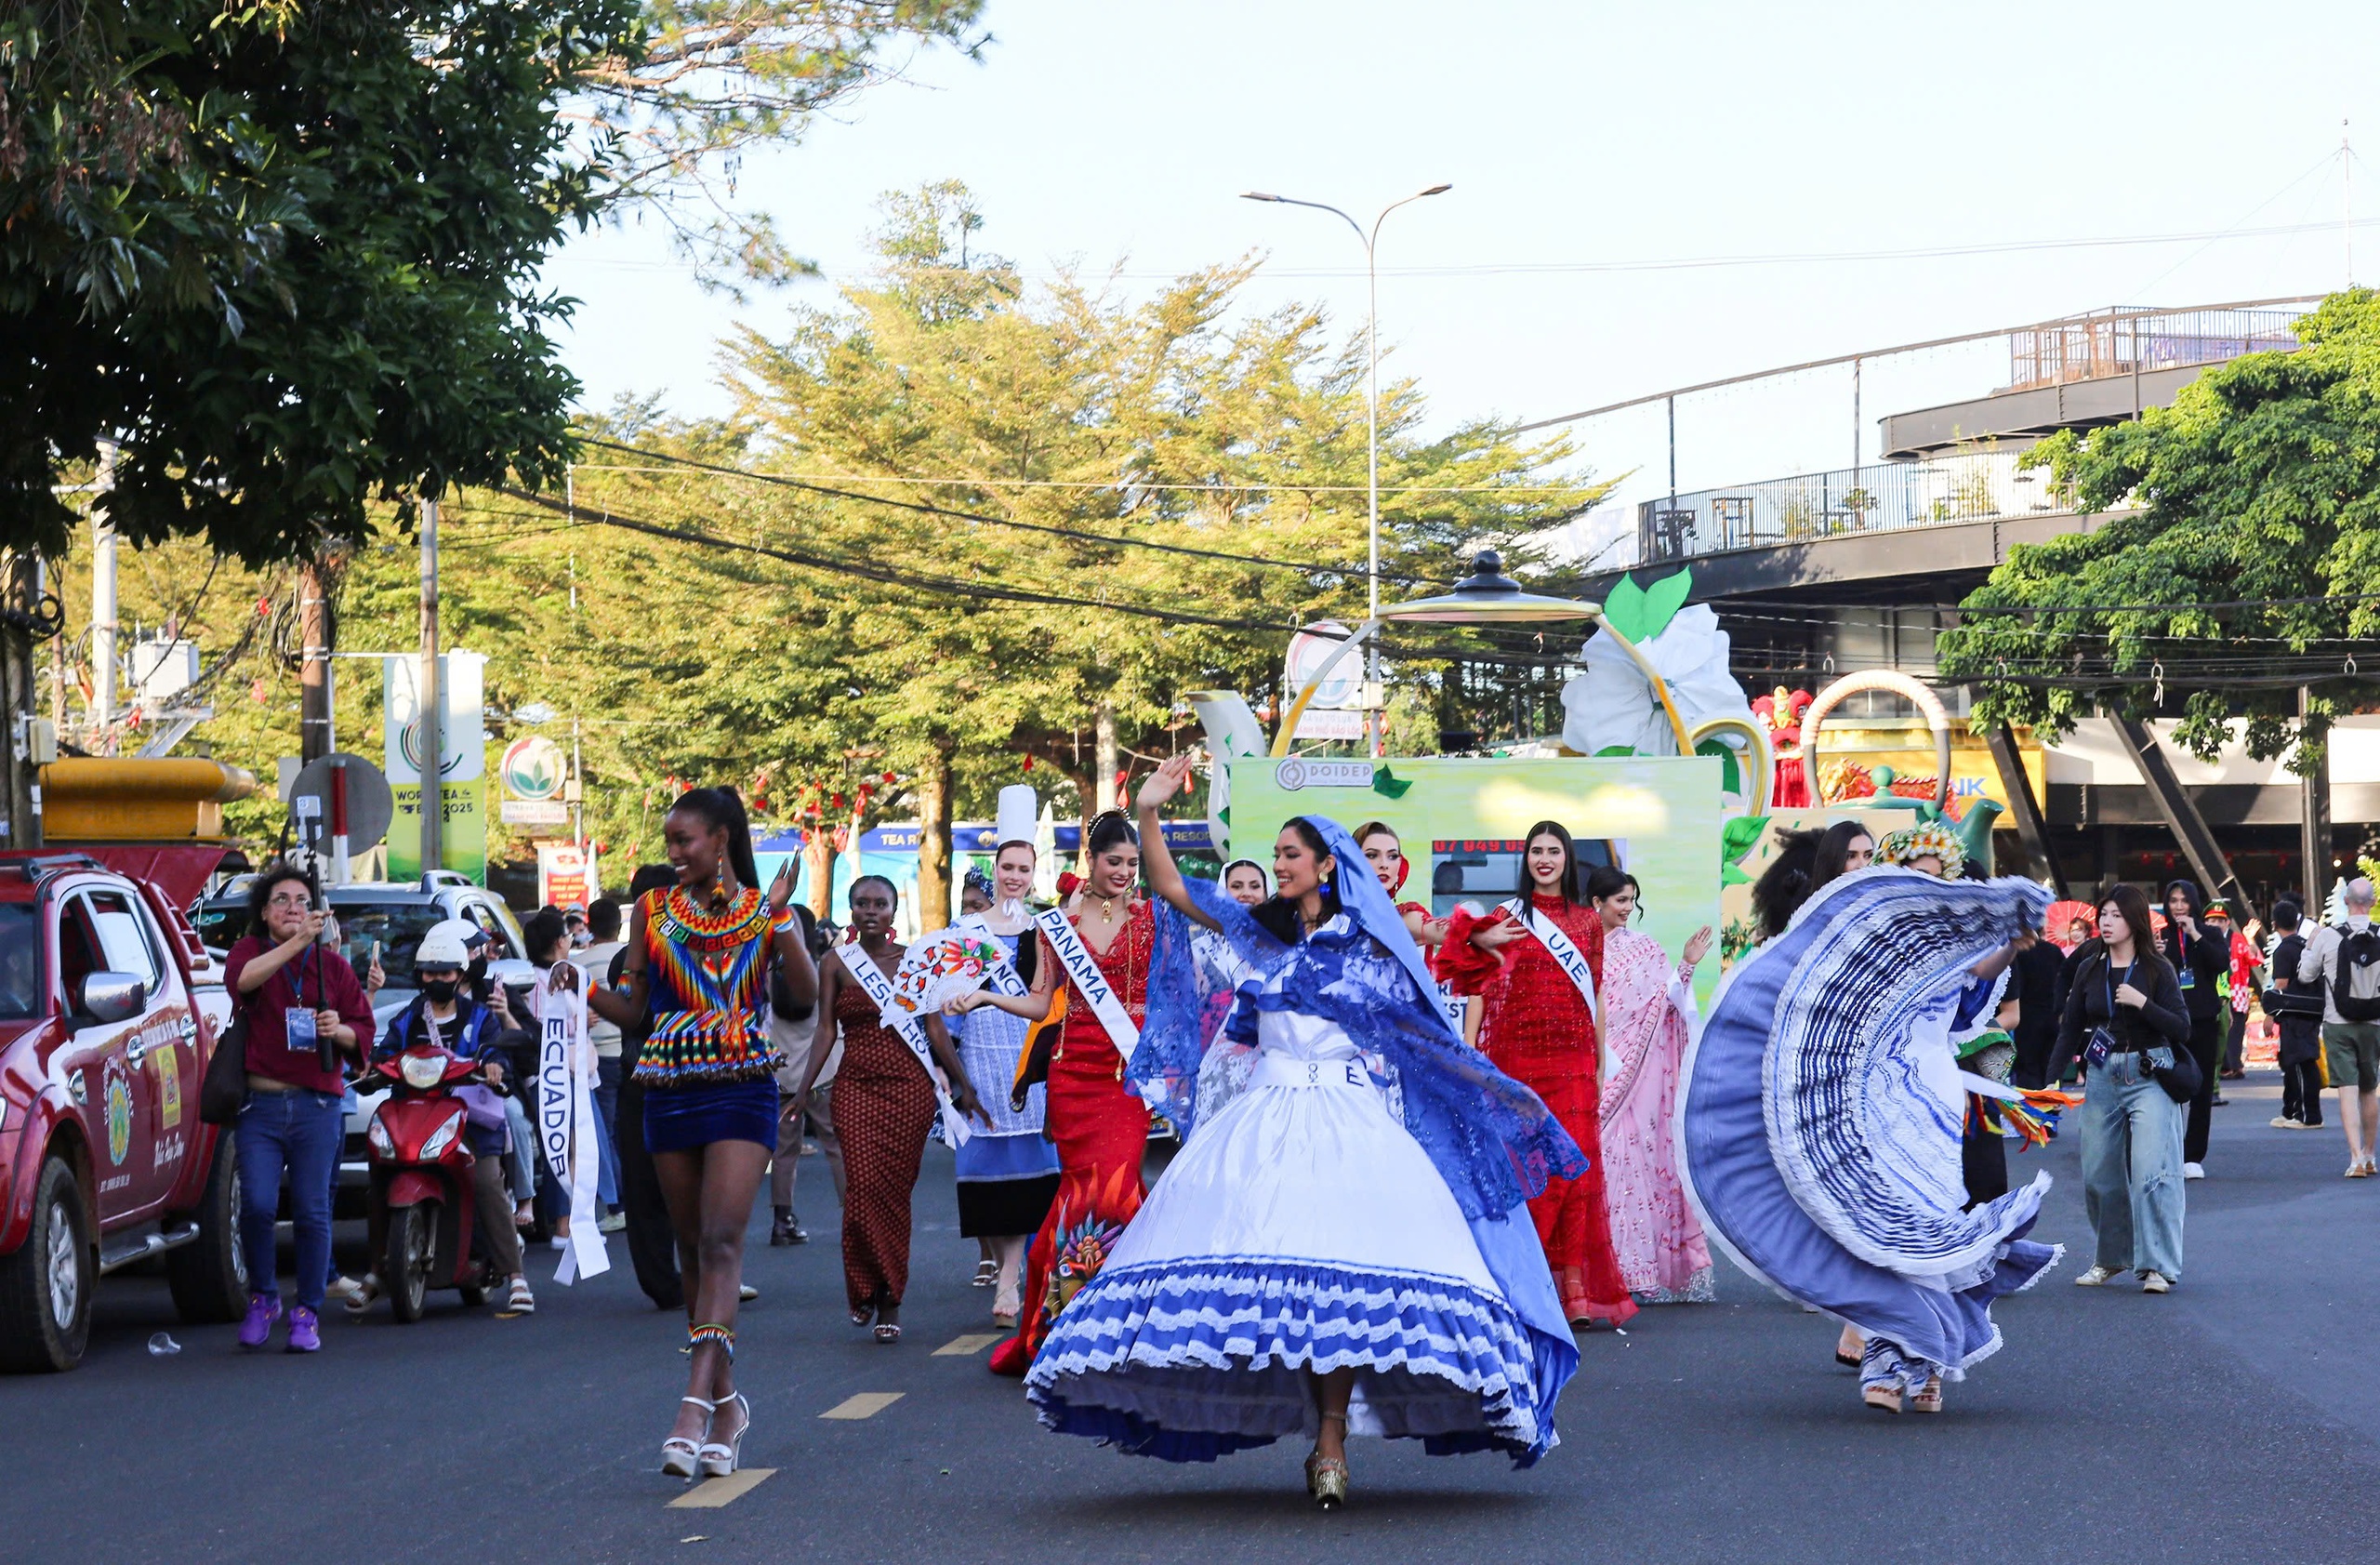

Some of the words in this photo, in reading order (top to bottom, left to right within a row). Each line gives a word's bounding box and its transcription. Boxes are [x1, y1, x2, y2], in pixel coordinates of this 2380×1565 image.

[1310, 765, 1370, 776] DOIDEP
[880, 834, 905, 845] TEA
[1041, 910, 1108, 1005] PANAMA
[1548, 933, 1588, 983] UAE
[854, 961, 927, 1054] LESHO
[544, 1017, 566, 1177] ECUADOR
